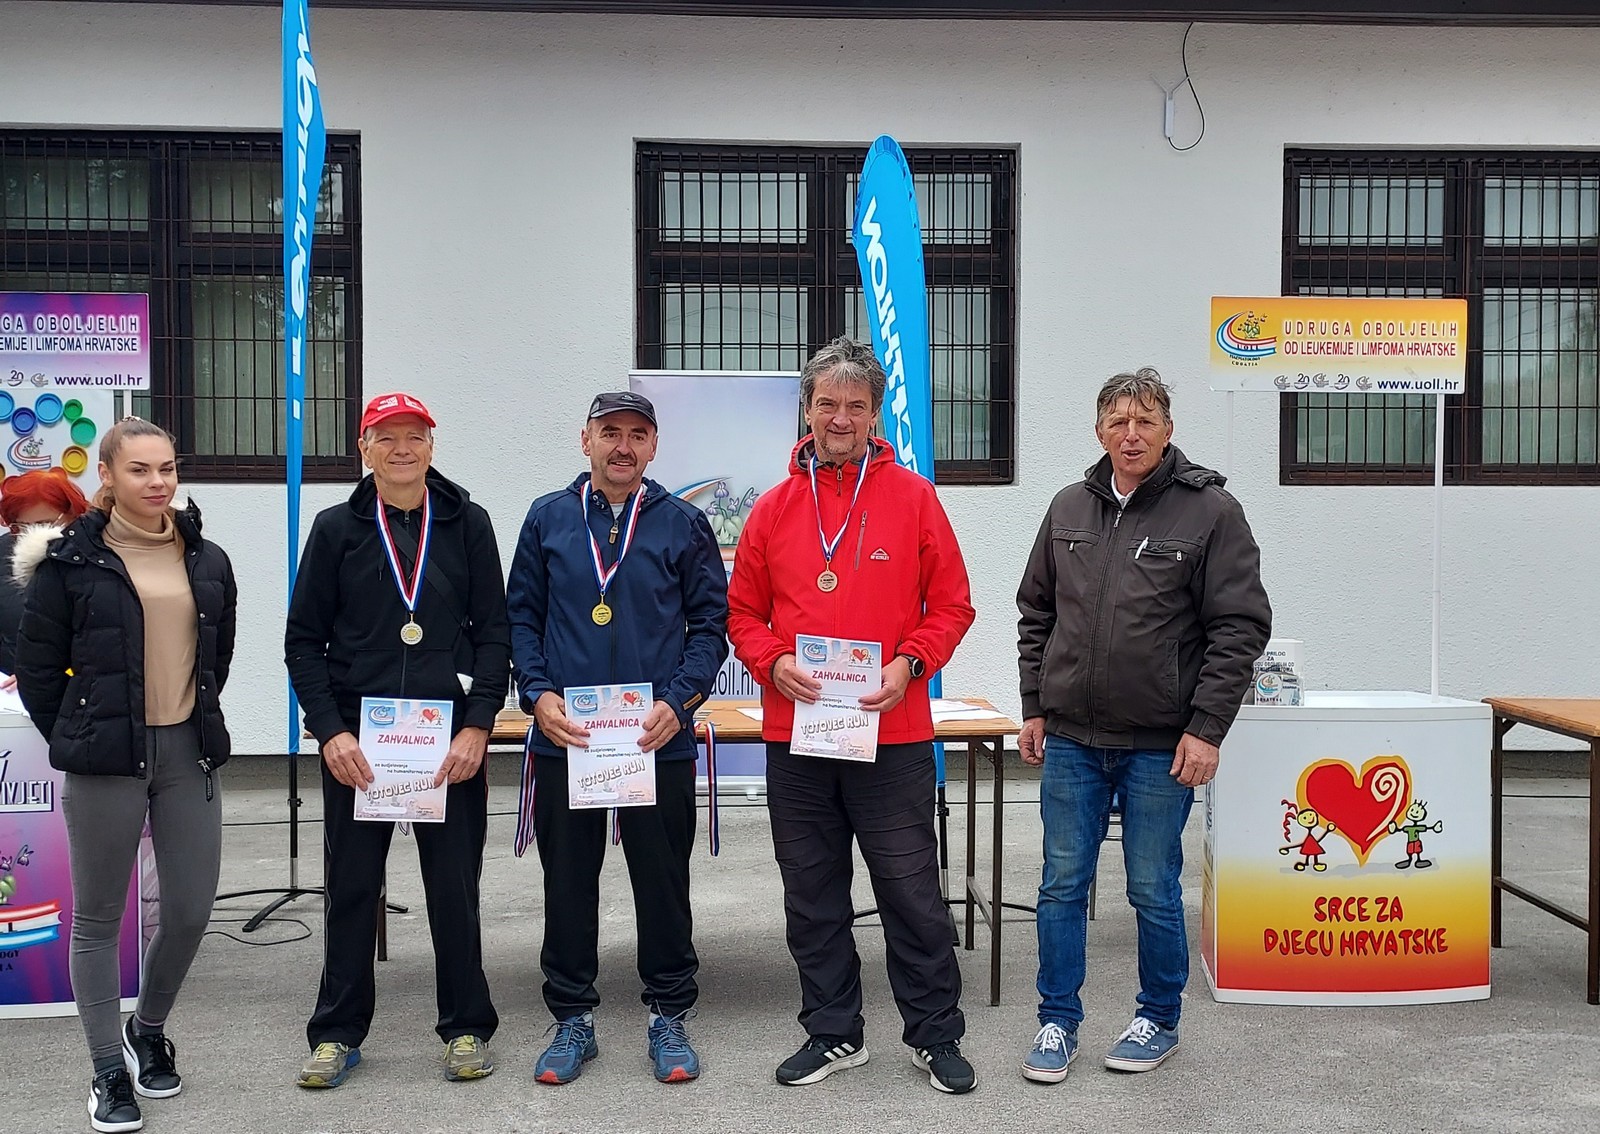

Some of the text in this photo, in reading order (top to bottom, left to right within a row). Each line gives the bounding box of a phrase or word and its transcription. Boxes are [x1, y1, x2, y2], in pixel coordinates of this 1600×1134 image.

[36, 316, 138, 331] OBOLJELIH
[1285, 321, 1457, 336] UDRUGA OBOLJELIH
[36, 337, 82, 351] LIMFOMA
[85, 337, 138, 351] HRVATSKE
[1284, 341, 1299, 355] OD
[1301, 341, 1354, 355] LEUKEMIJE
[1362, 342, 1404, 356] LIMFOMA
[1407, 342, 1456, 356] HRVATSKE
[54, 374, 143, 386] www.uoll.hr
[1377, 378, 1459, 390] www.uoll.hr
[811, 670, 867, 683] ZAHVALNICA
[584, 718, 640, 730] ZAHVALNICA
[801, 713, 869, 735] TOTOVEC RUN
[377, 734, 435, 745] ZAHVALNICA
[577, 758, 646, 788] TOTOVEC RUN
[365, 777, 436, 801] TOTOVEC RUN
[1313, 895, 1404, 923] SRCE ZA
[1263, 927, 1449, 957] DJECU HRVATSKE
